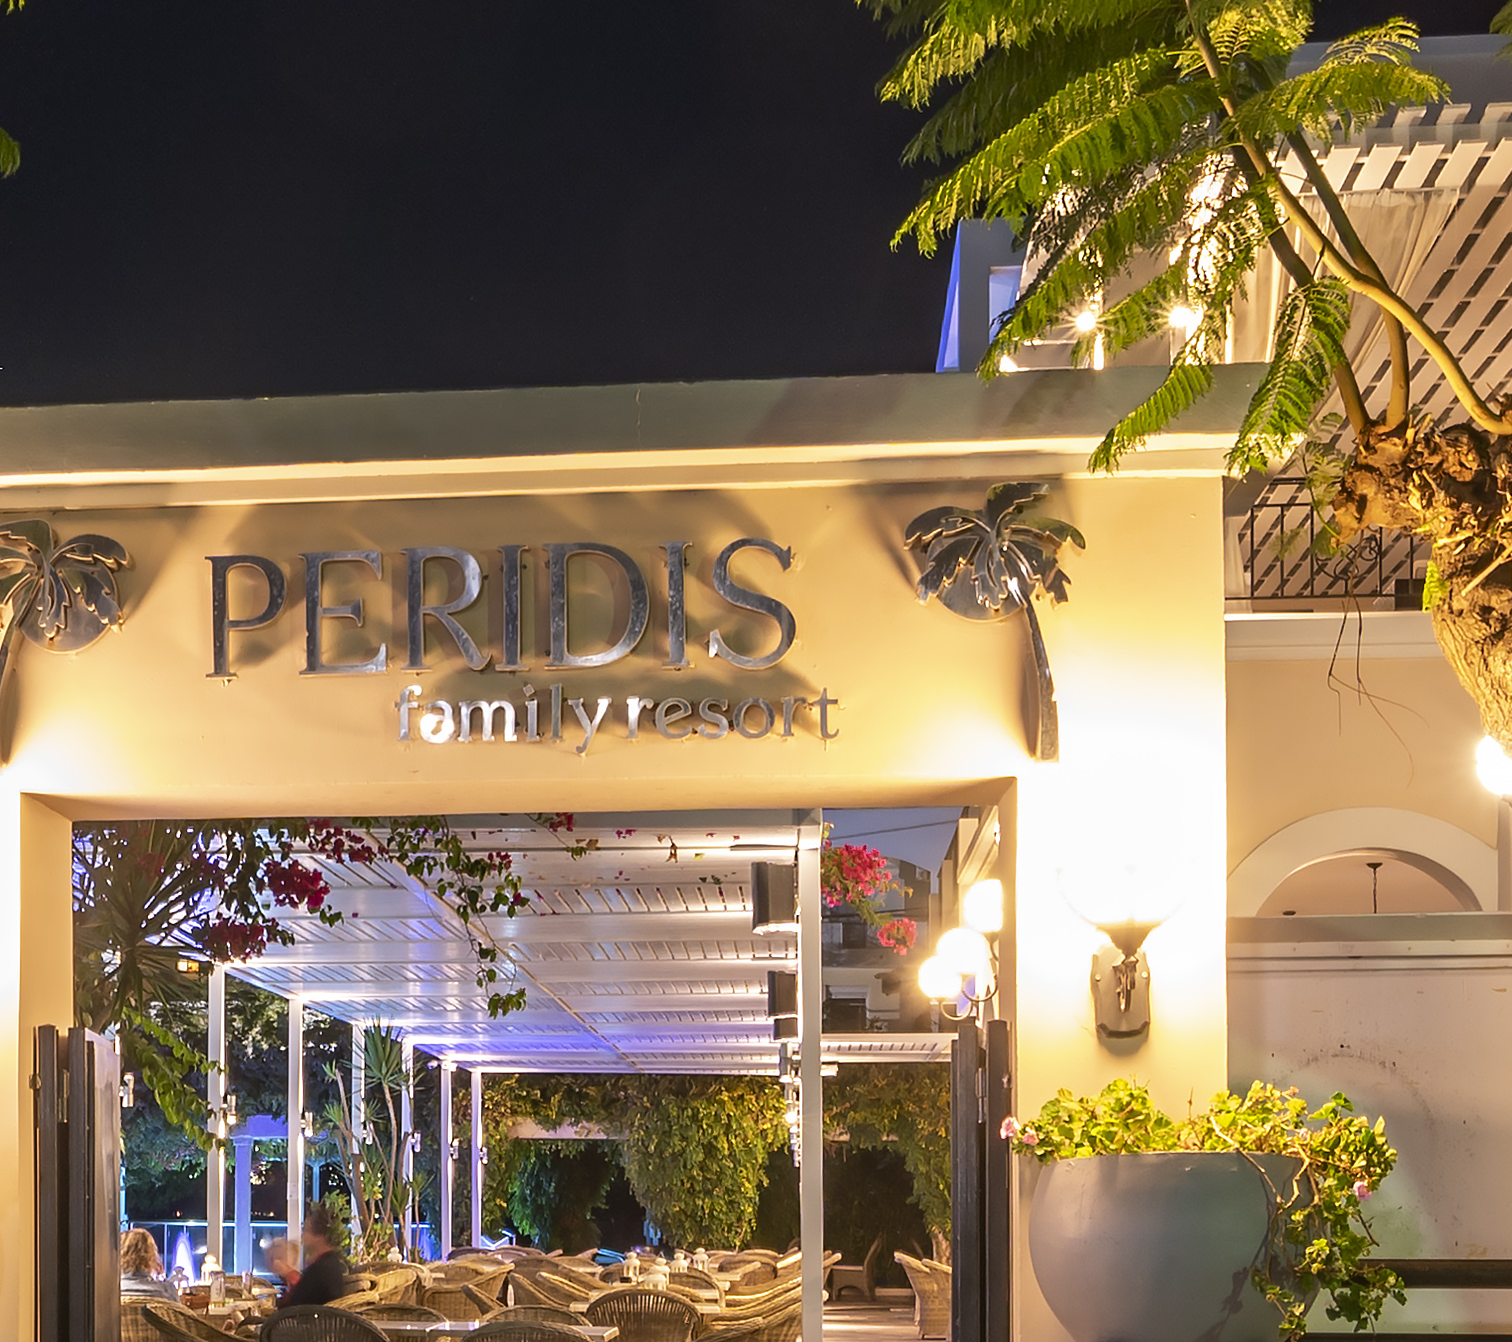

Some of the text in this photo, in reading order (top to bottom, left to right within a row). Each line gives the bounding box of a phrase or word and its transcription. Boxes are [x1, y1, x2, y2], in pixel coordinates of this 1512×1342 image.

[203, 536, 798, 680] PERIDIS
[394, 683, 840, 756] family resort
